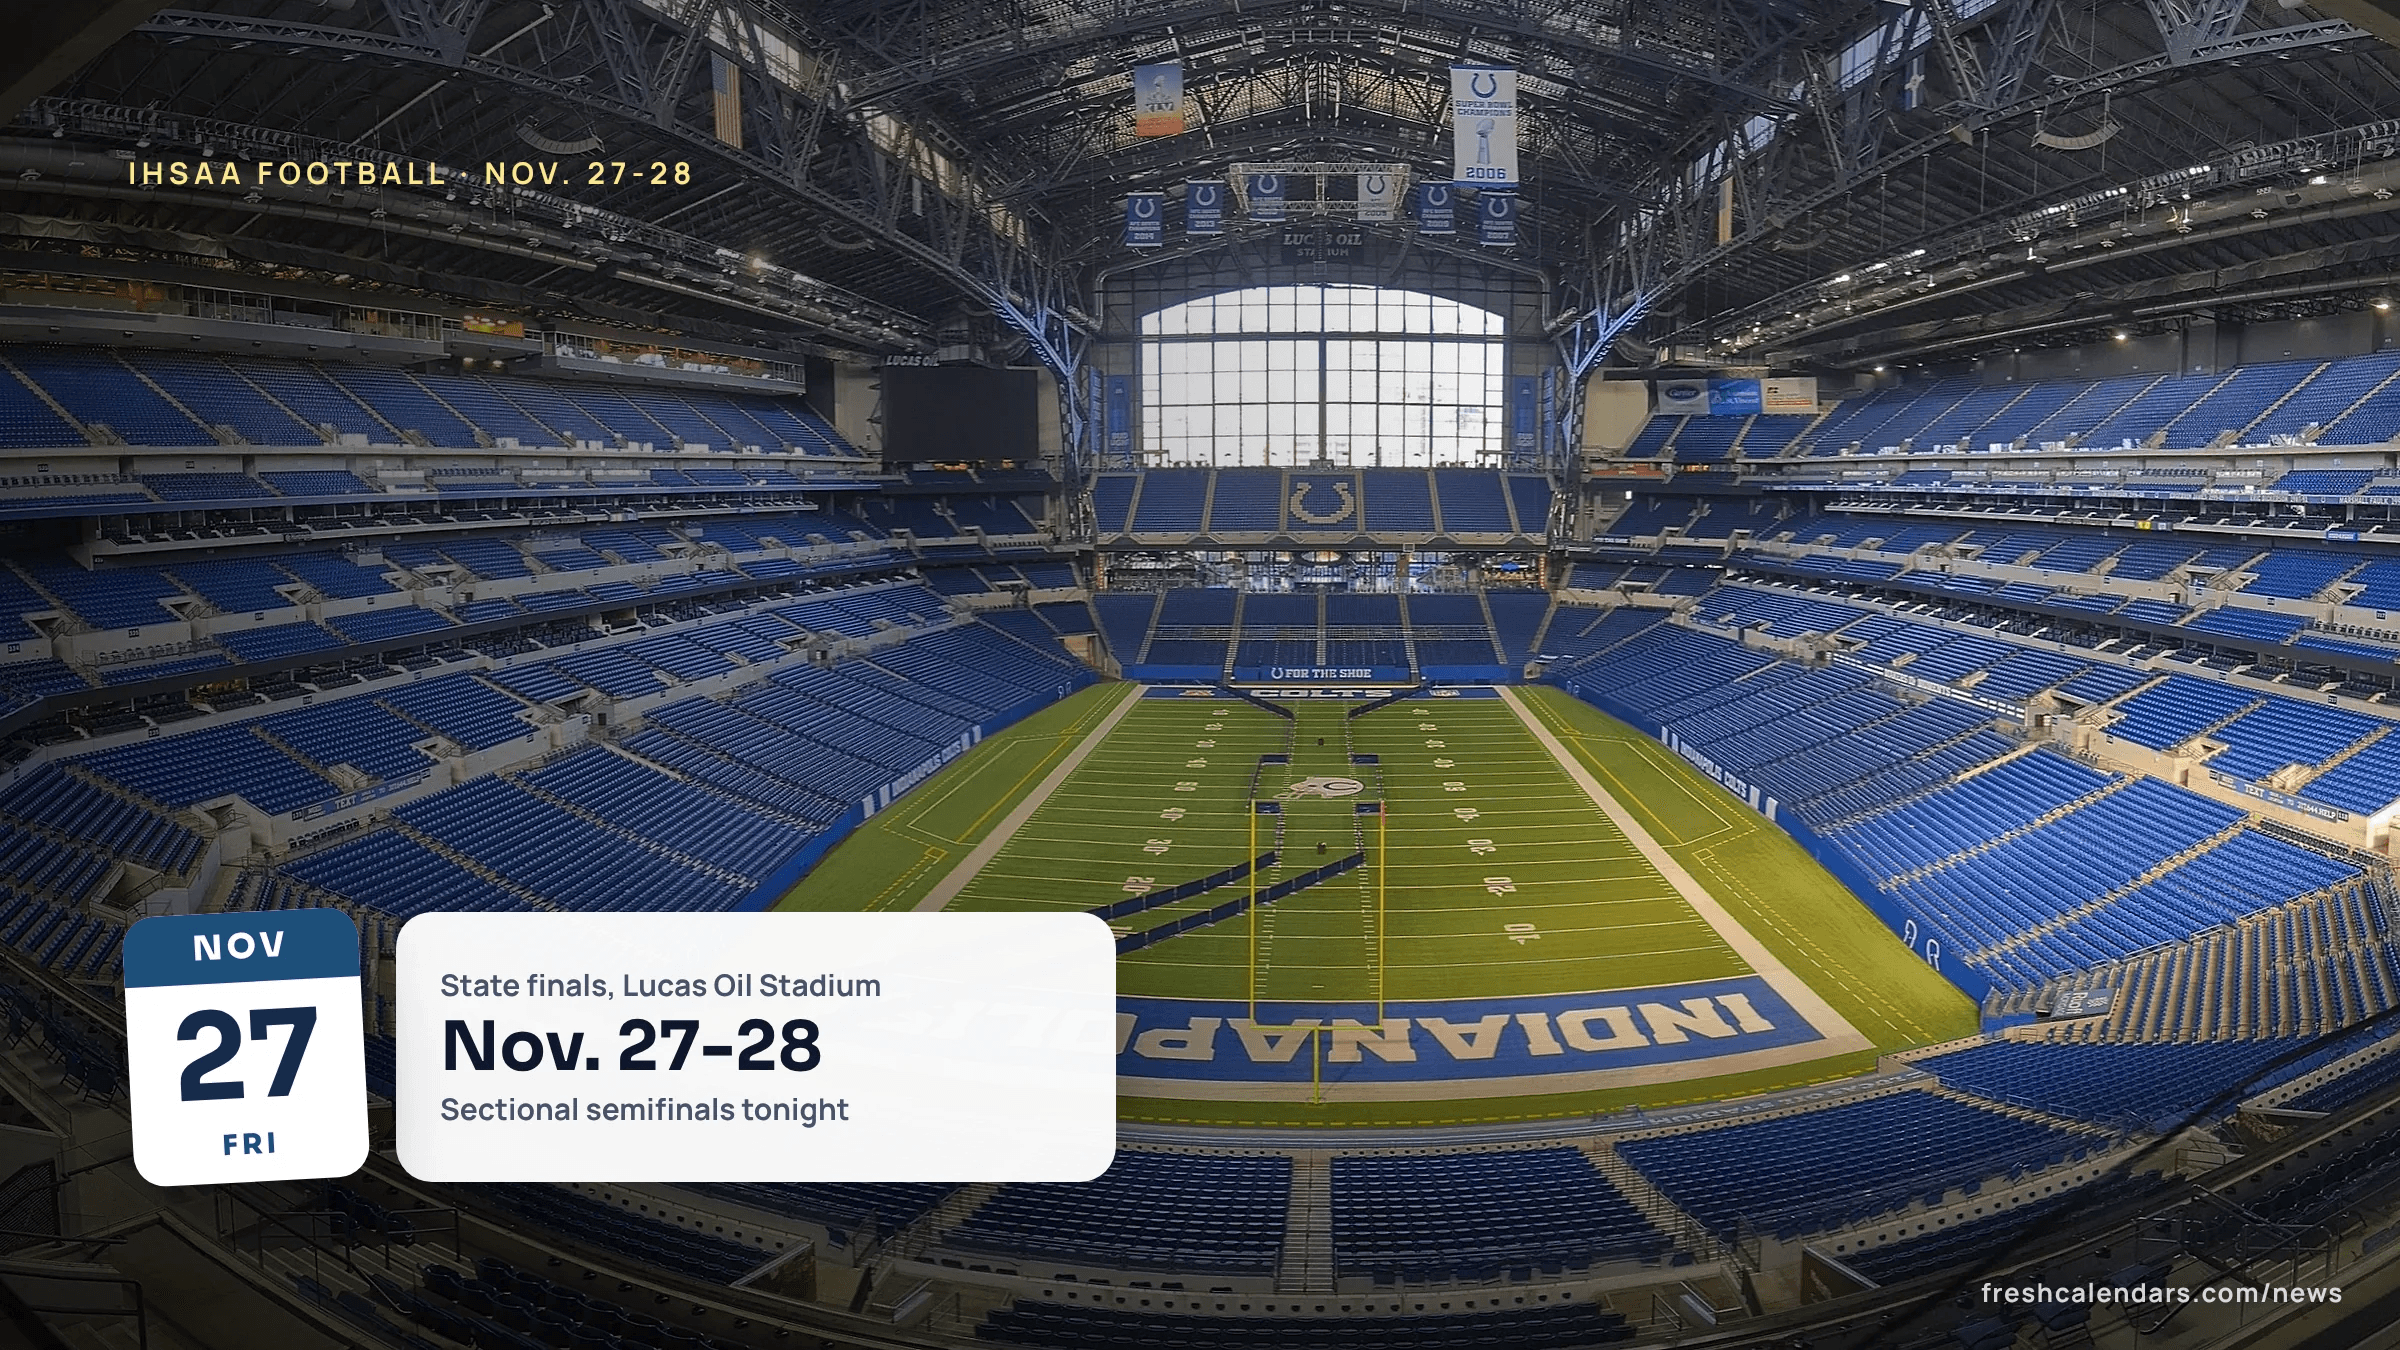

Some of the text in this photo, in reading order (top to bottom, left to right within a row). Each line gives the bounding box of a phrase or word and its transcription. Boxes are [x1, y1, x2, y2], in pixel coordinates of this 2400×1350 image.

[1487, 101, 1513, 109] BOWL
[1457, 109, 1512, 117] CHAMPIONS
[1466, 167, 1506, 179] 2006
[1283, 233, 1362, 246] LUCS OIL
[1297, 248, 1349, 256] STAIUM
[887, 355, 921, 366] LUCAS
[1285, 669, 1372, 678] FOR THE SHOE
[1250, 689, 1393, 698] COLTS
[2244, 783, 2265, 798] TEXT
[335, 795, 357, 810] TEXT
[1116, 993, 1776, 1062] INDIANAP
